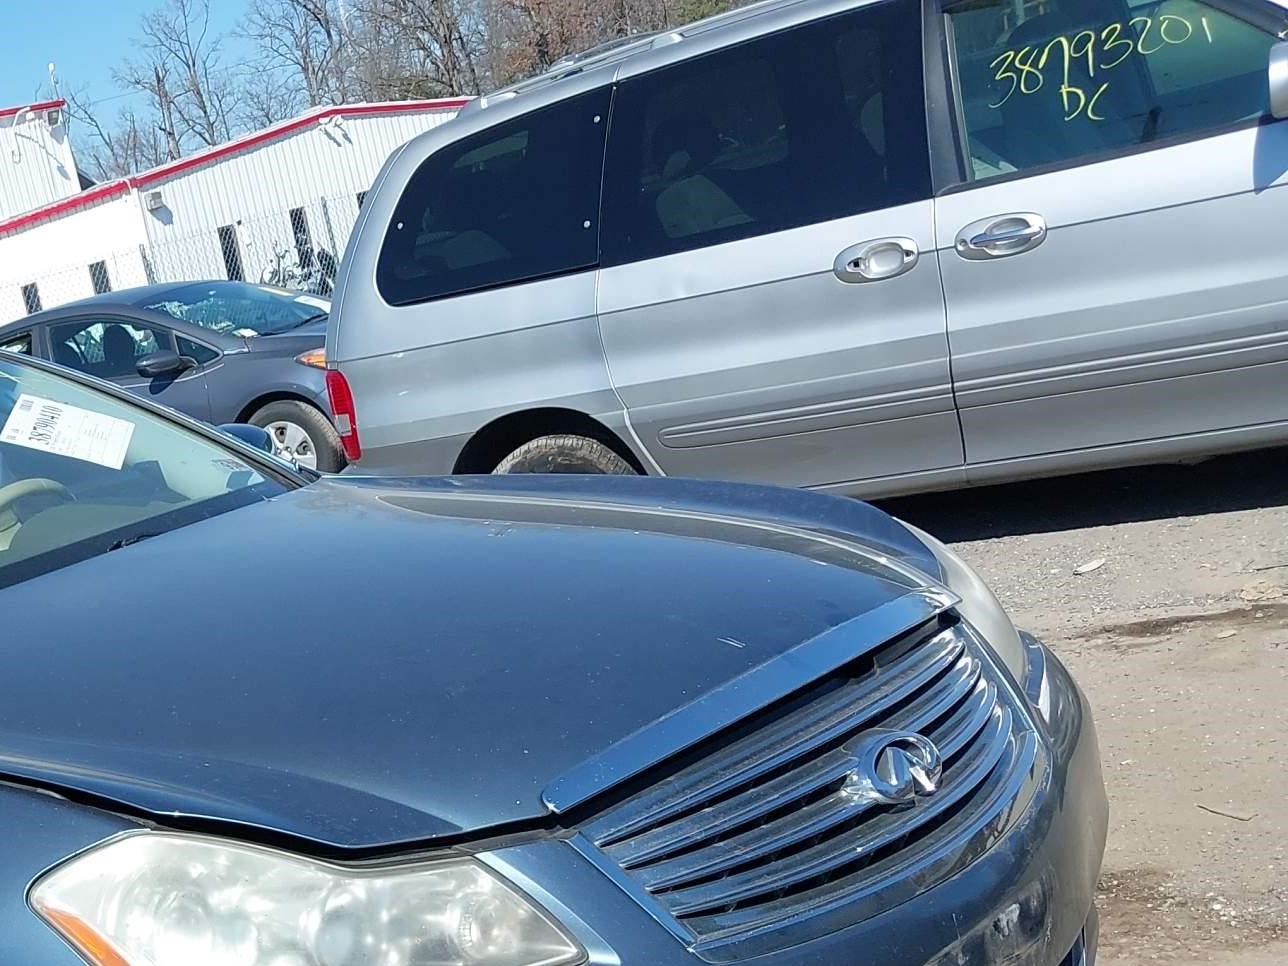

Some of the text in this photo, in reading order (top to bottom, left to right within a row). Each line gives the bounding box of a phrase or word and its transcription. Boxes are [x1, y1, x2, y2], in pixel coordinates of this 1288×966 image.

[988, 15, 1213, 108] 38793201
[1060, 82, 1109, 121] DC
[28, 405, 63, 445] 38790410
